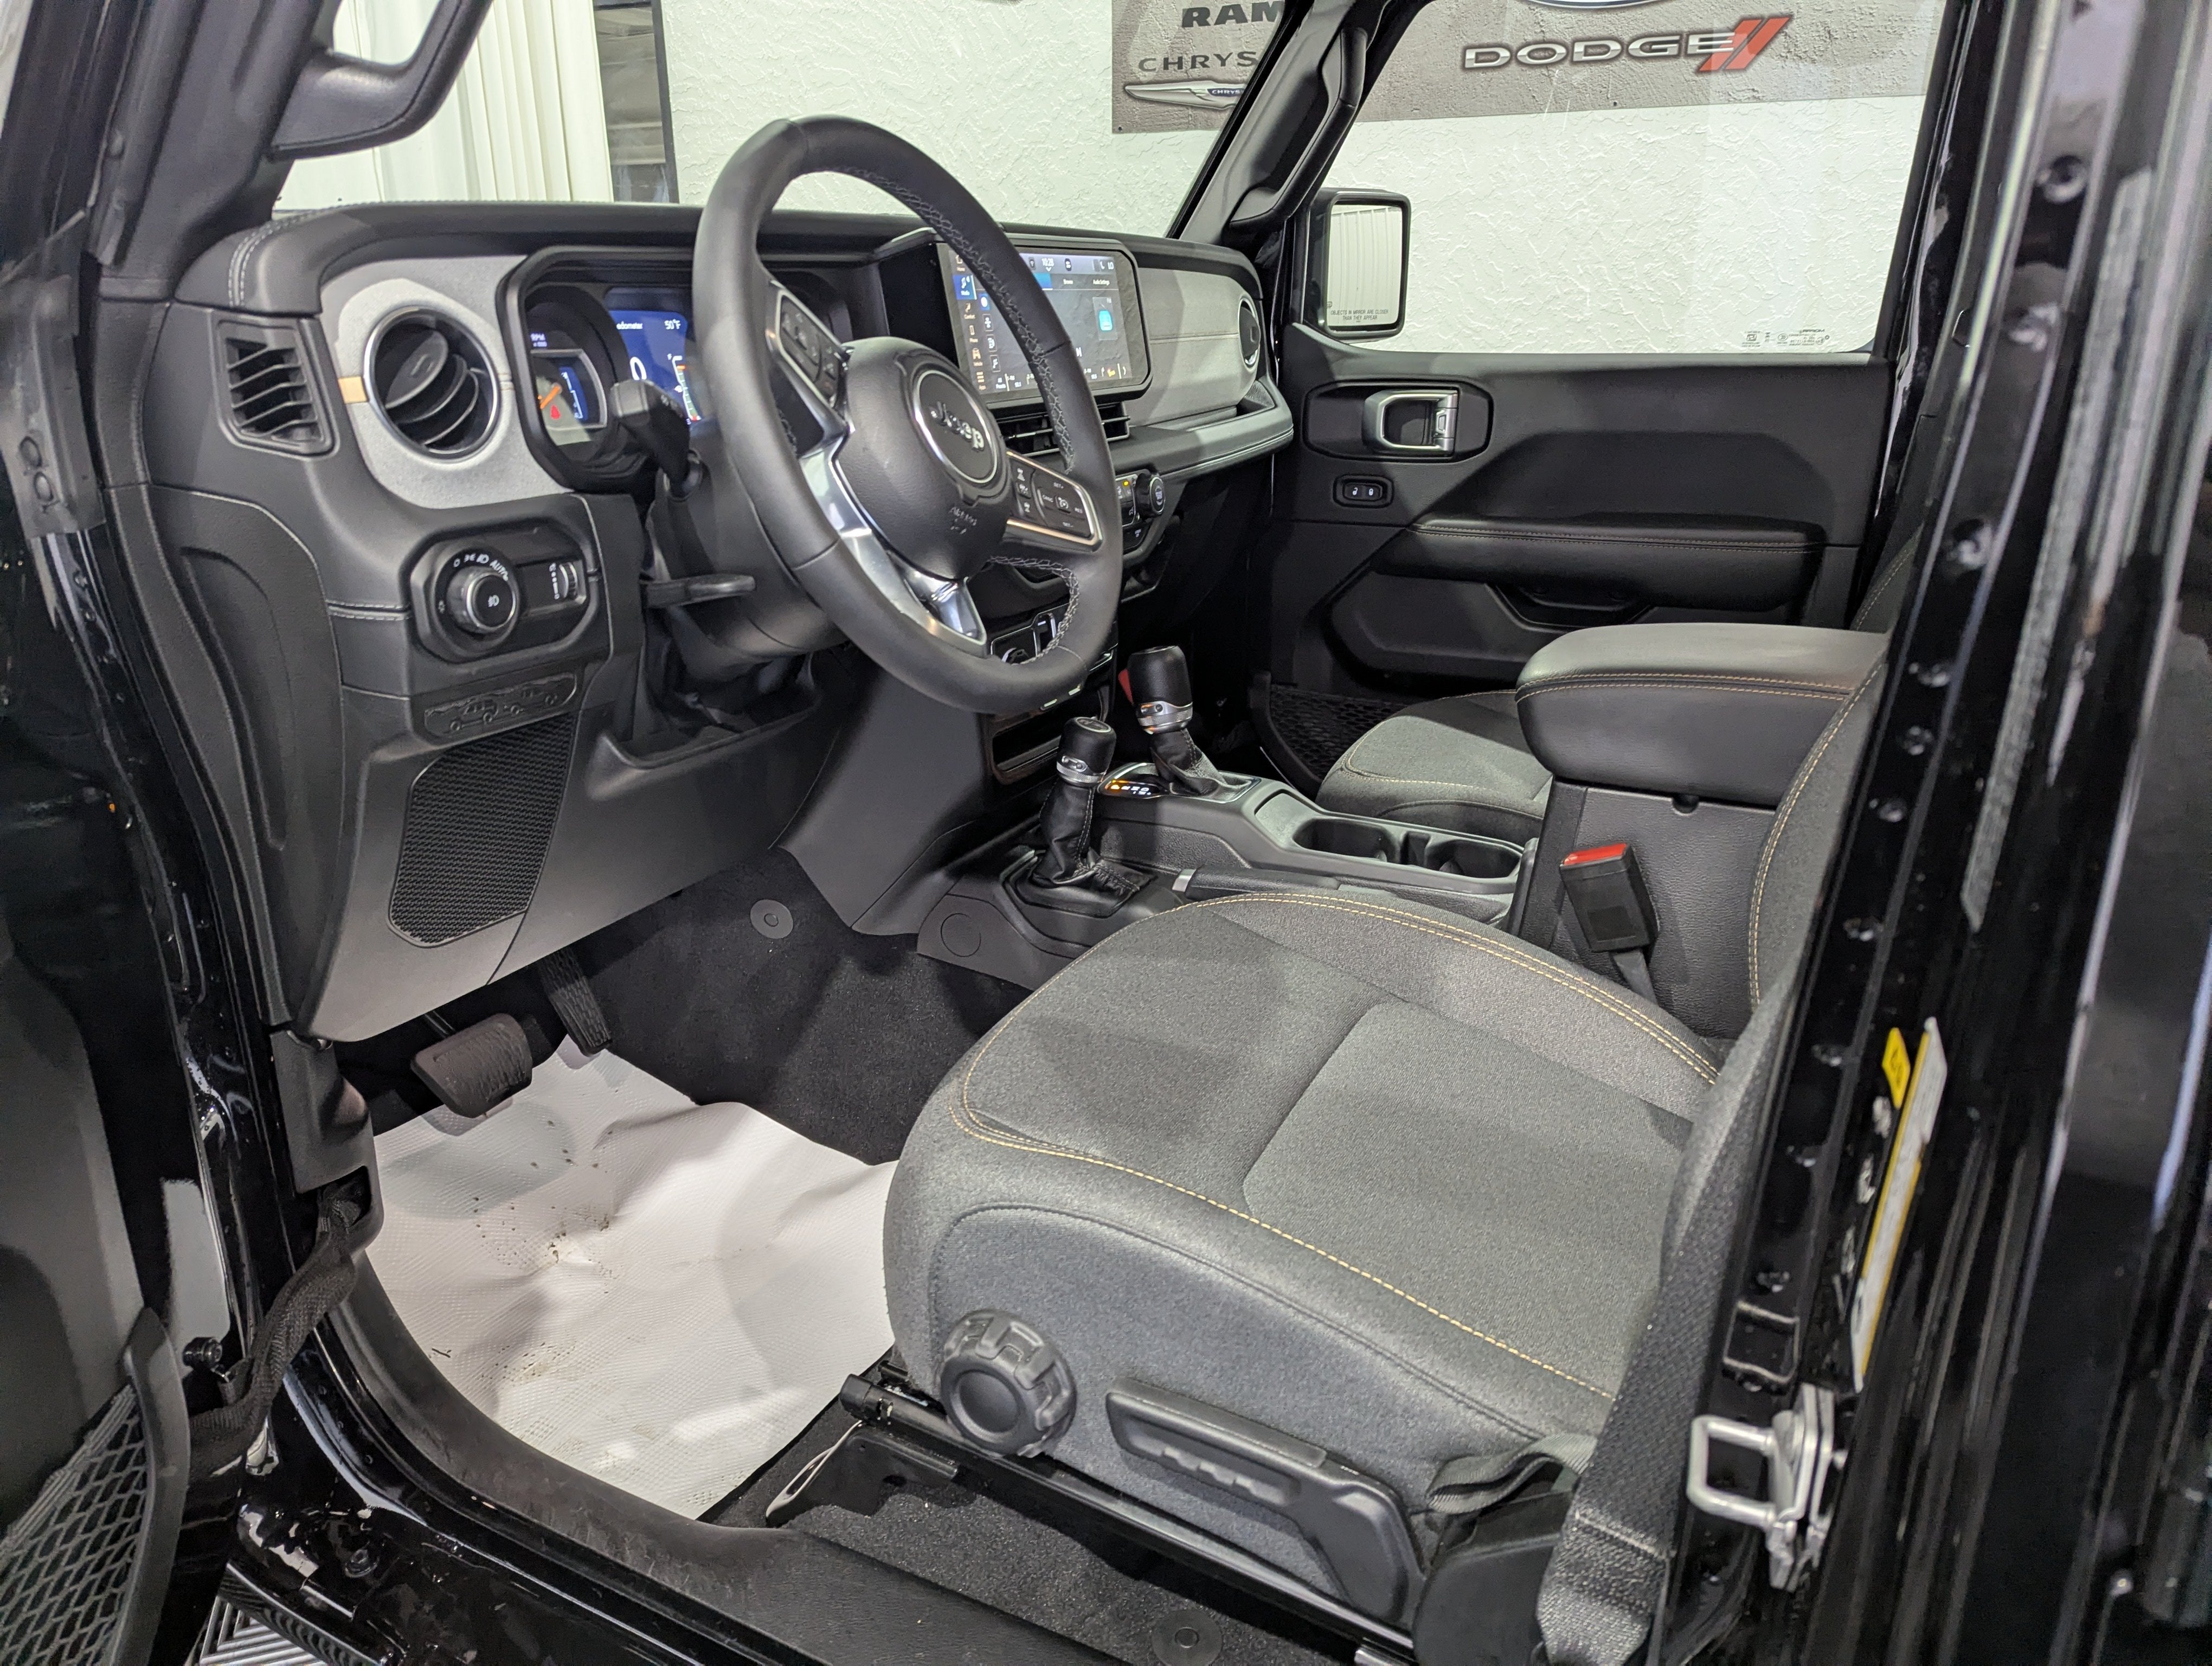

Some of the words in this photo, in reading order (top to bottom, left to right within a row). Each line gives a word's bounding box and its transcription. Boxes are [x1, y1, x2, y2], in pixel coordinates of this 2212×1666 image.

[1182, 1, 1285, 27] RAM
[1139, 51, 1259, 72] CHRYS
[1464, 32, 1735, 68] DODGE
[931, 401, 985, 450] Jeep
[490, 559, 509, 581] AUTO
